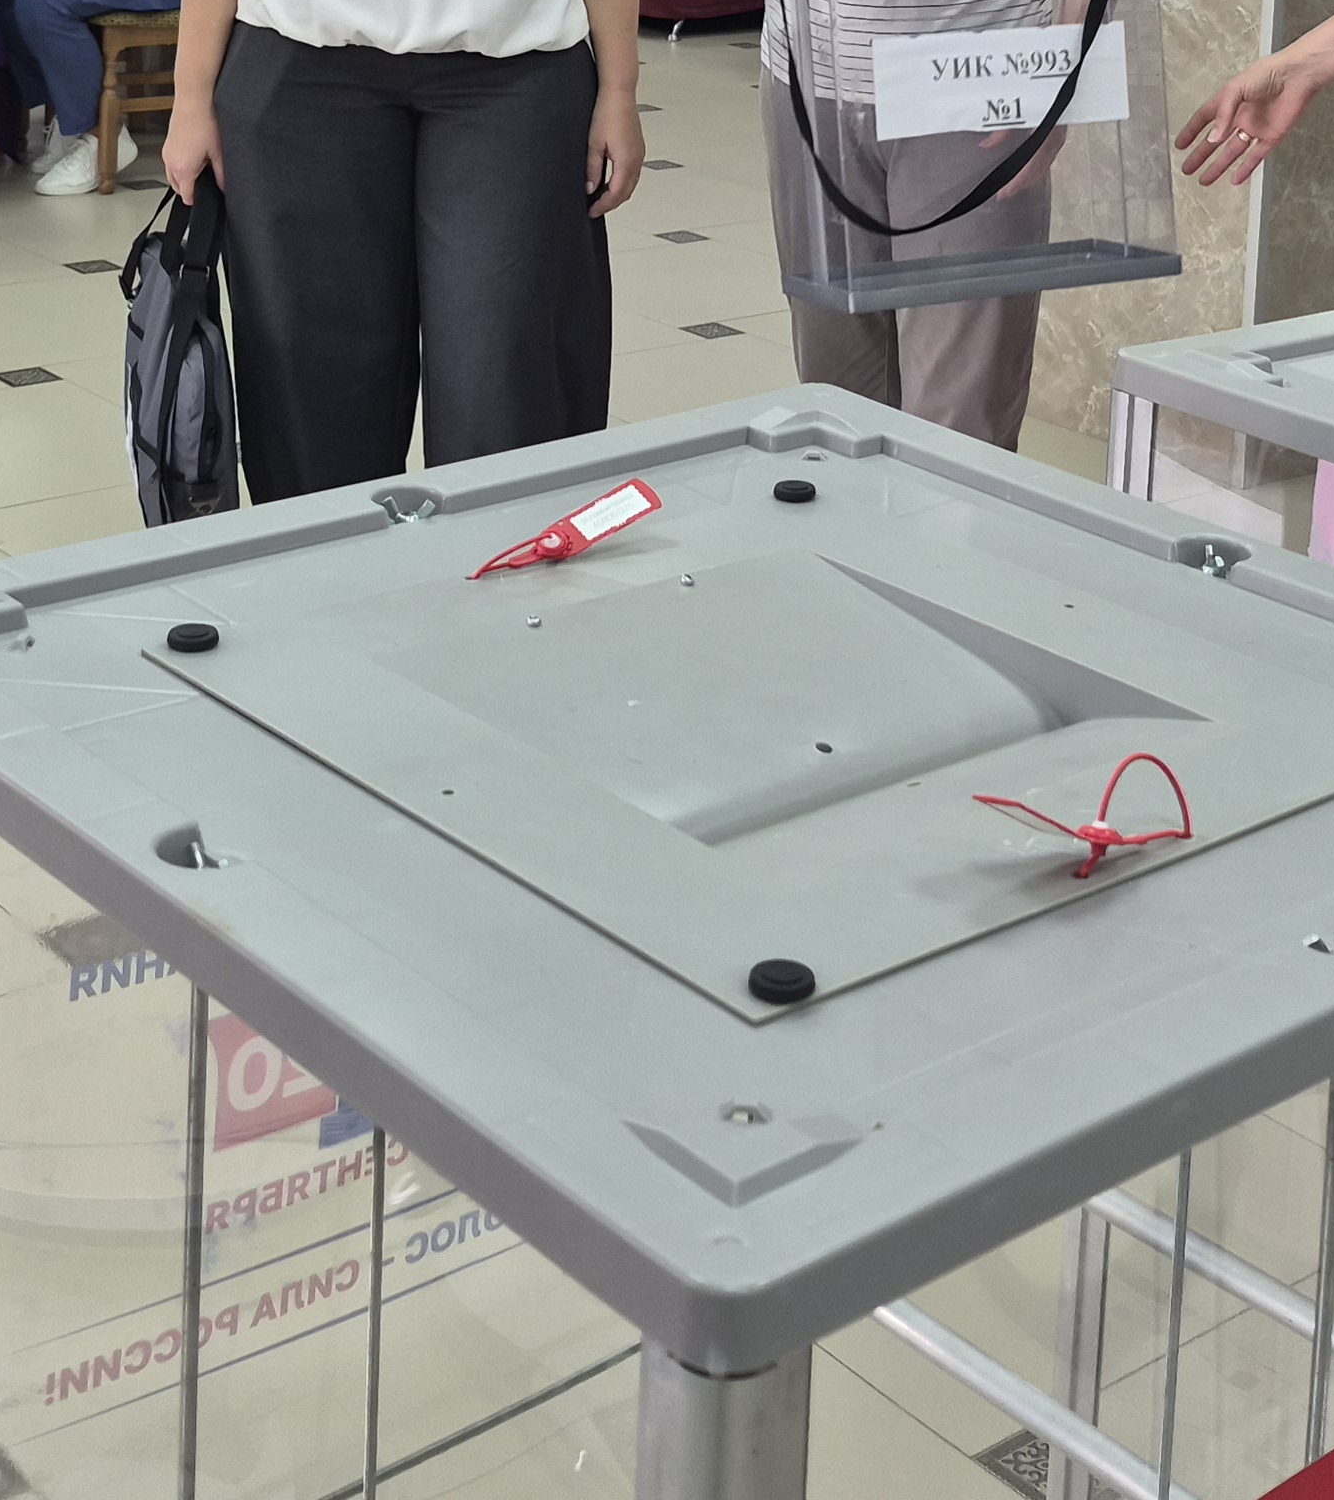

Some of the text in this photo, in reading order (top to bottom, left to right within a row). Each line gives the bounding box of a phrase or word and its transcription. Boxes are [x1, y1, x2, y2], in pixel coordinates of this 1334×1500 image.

[932, 48, 1073, 81] УИК №993
[982, 95, 1023, 124] №1
